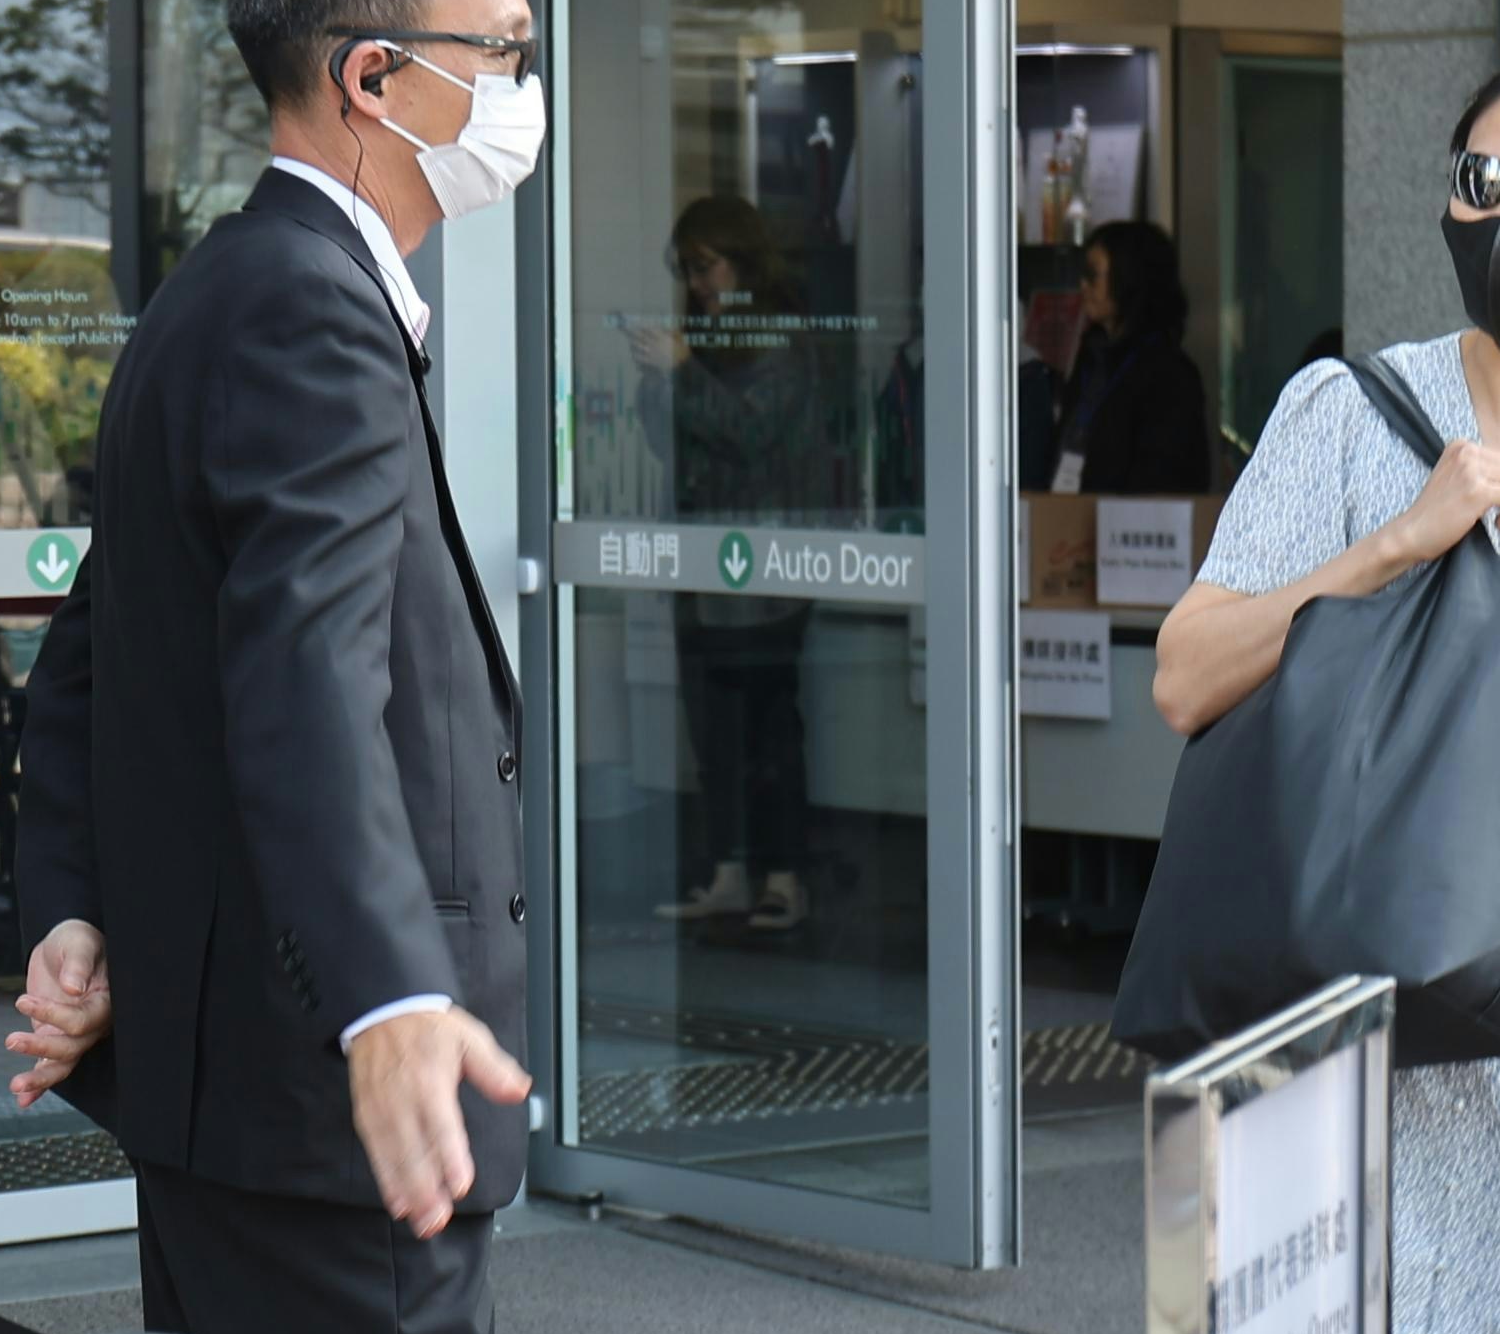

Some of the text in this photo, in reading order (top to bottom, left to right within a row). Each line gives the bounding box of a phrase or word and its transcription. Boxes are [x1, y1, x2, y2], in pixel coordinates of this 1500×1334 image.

[1, 289, 88, 306] Opening Hours
[48, 313, 60, 327] to
[79, 331, 110, 345] Public
[599, 531, 680, 579] 自動門
[764, 540, 913, 587] Auto Door
